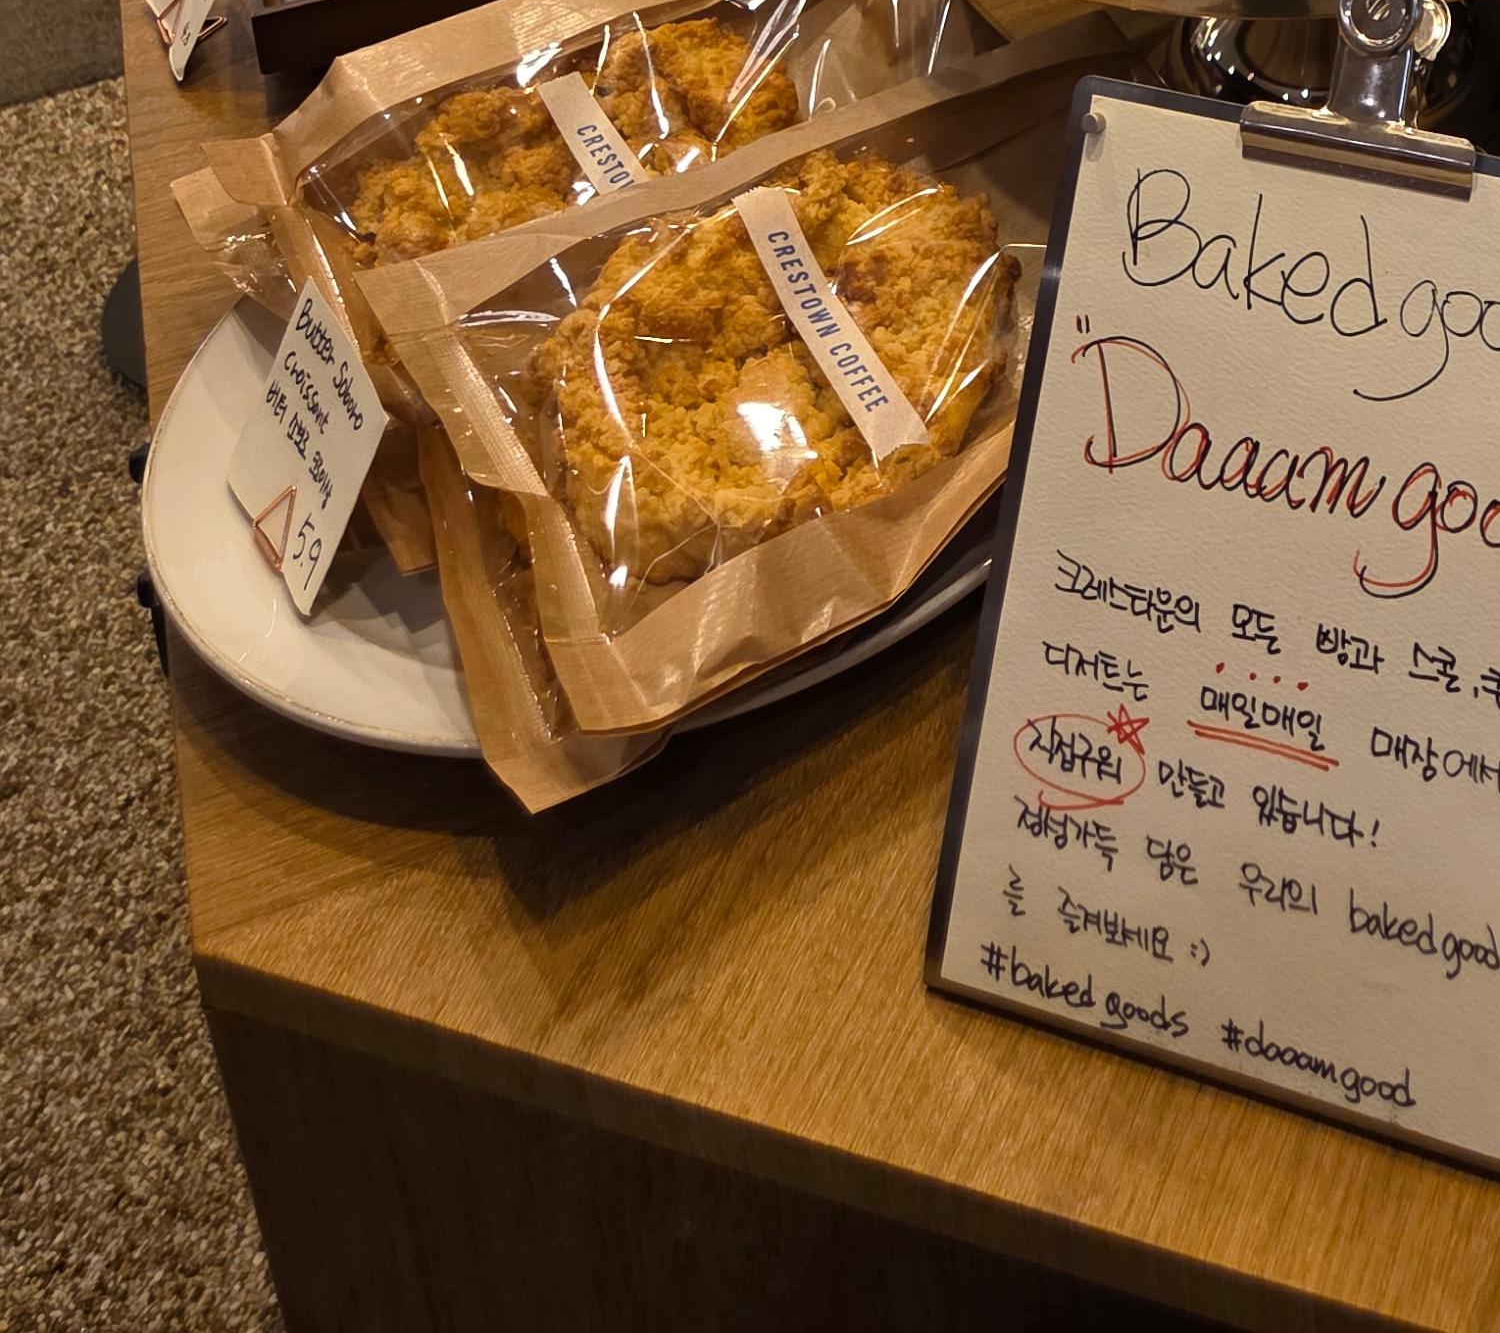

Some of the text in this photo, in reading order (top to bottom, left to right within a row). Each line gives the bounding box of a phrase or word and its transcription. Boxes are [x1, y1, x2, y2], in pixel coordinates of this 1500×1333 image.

[294, 297, 336, 366] Butter
[767, 229, 891, 414] CRESTOWN COFFEE
[291, 512, 324, 592] 5.9
[1053, 548, 1202, 633] 크레스타운의
[1231, 601, 1282, 658] 모든
[1315, 621, 1387, 677] 빵과
[1041, 638, 1152, 702] 디저트는
[1199, 684, 1327, 754] 매일매일
[1158, 757, 1227, 812] 만들고
[1252, 783, 1382, 849] 있습니다!
[1001, 863, 1027, 921] 를
[1015, 795, 1120, 874] 정성가득
[1145, 832, 1200, 888] 담은
[1239, 861, 1320, 916] 우리의
